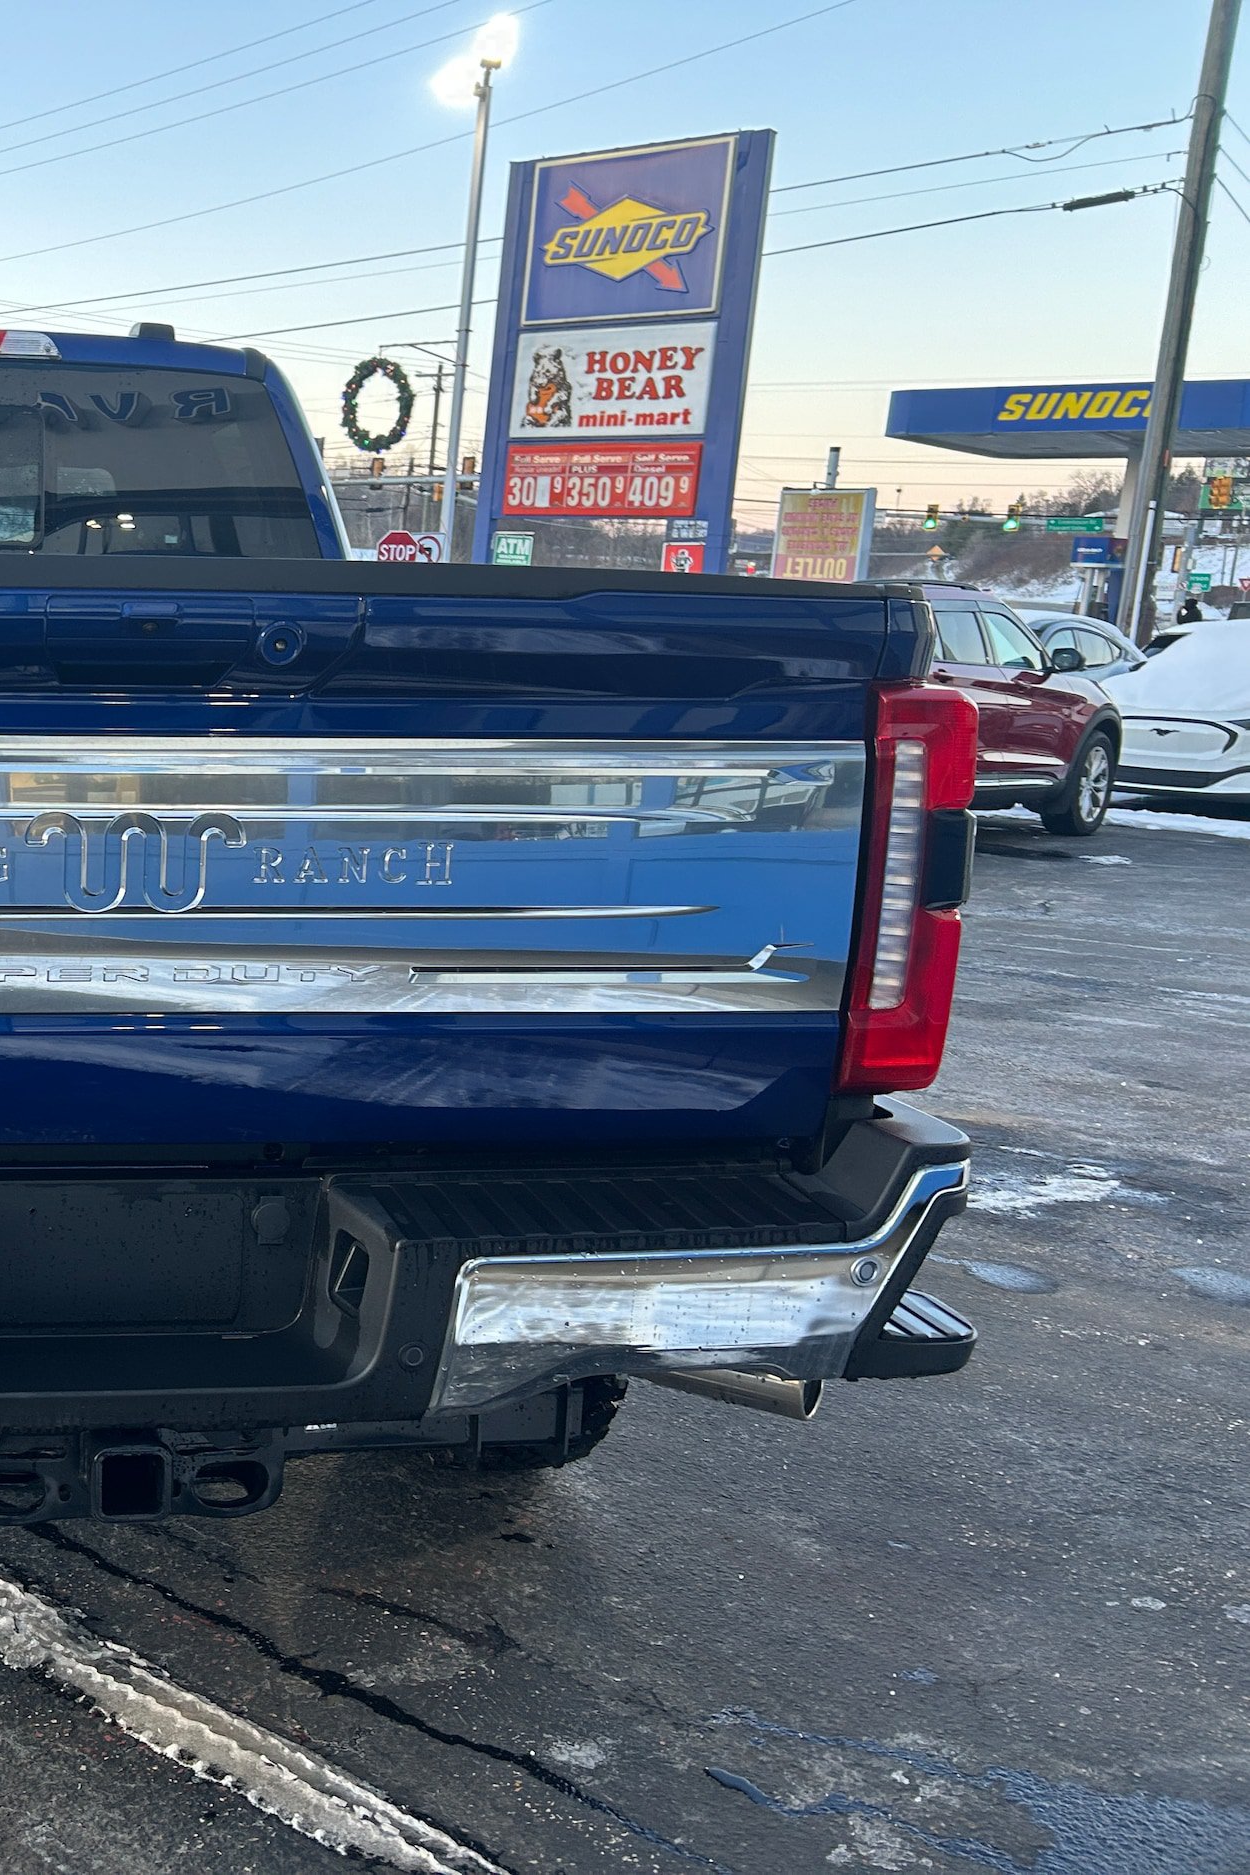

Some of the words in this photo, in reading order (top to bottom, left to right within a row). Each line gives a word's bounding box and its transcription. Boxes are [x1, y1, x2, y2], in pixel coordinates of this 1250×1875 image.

[551, 216, 701, 260] SUNOCO
[585, 346, 705, 374] HONEY
[592, 375, 686, 401] BEAR
[998, 390, 1151, 421] SUNOC
[578, 408, 691, 428] mini-mart
[593, 454, 622, 464] Serve
[658, 453, 690, 462] Serve
[572, 465, 598, 474] PLUS
[633, 465, 666, 473] Diesel
[567, 476, 611, 507] 350
[628, 476, 675, 507] 409
[379, 543, 416, 561] STOP
[498, 537, 531, 555] ATM
[782, 557, 848, 579] OUTLET
[253, 841, 455, 887] RANCH
[173, 963, 386, 984] DUTY
